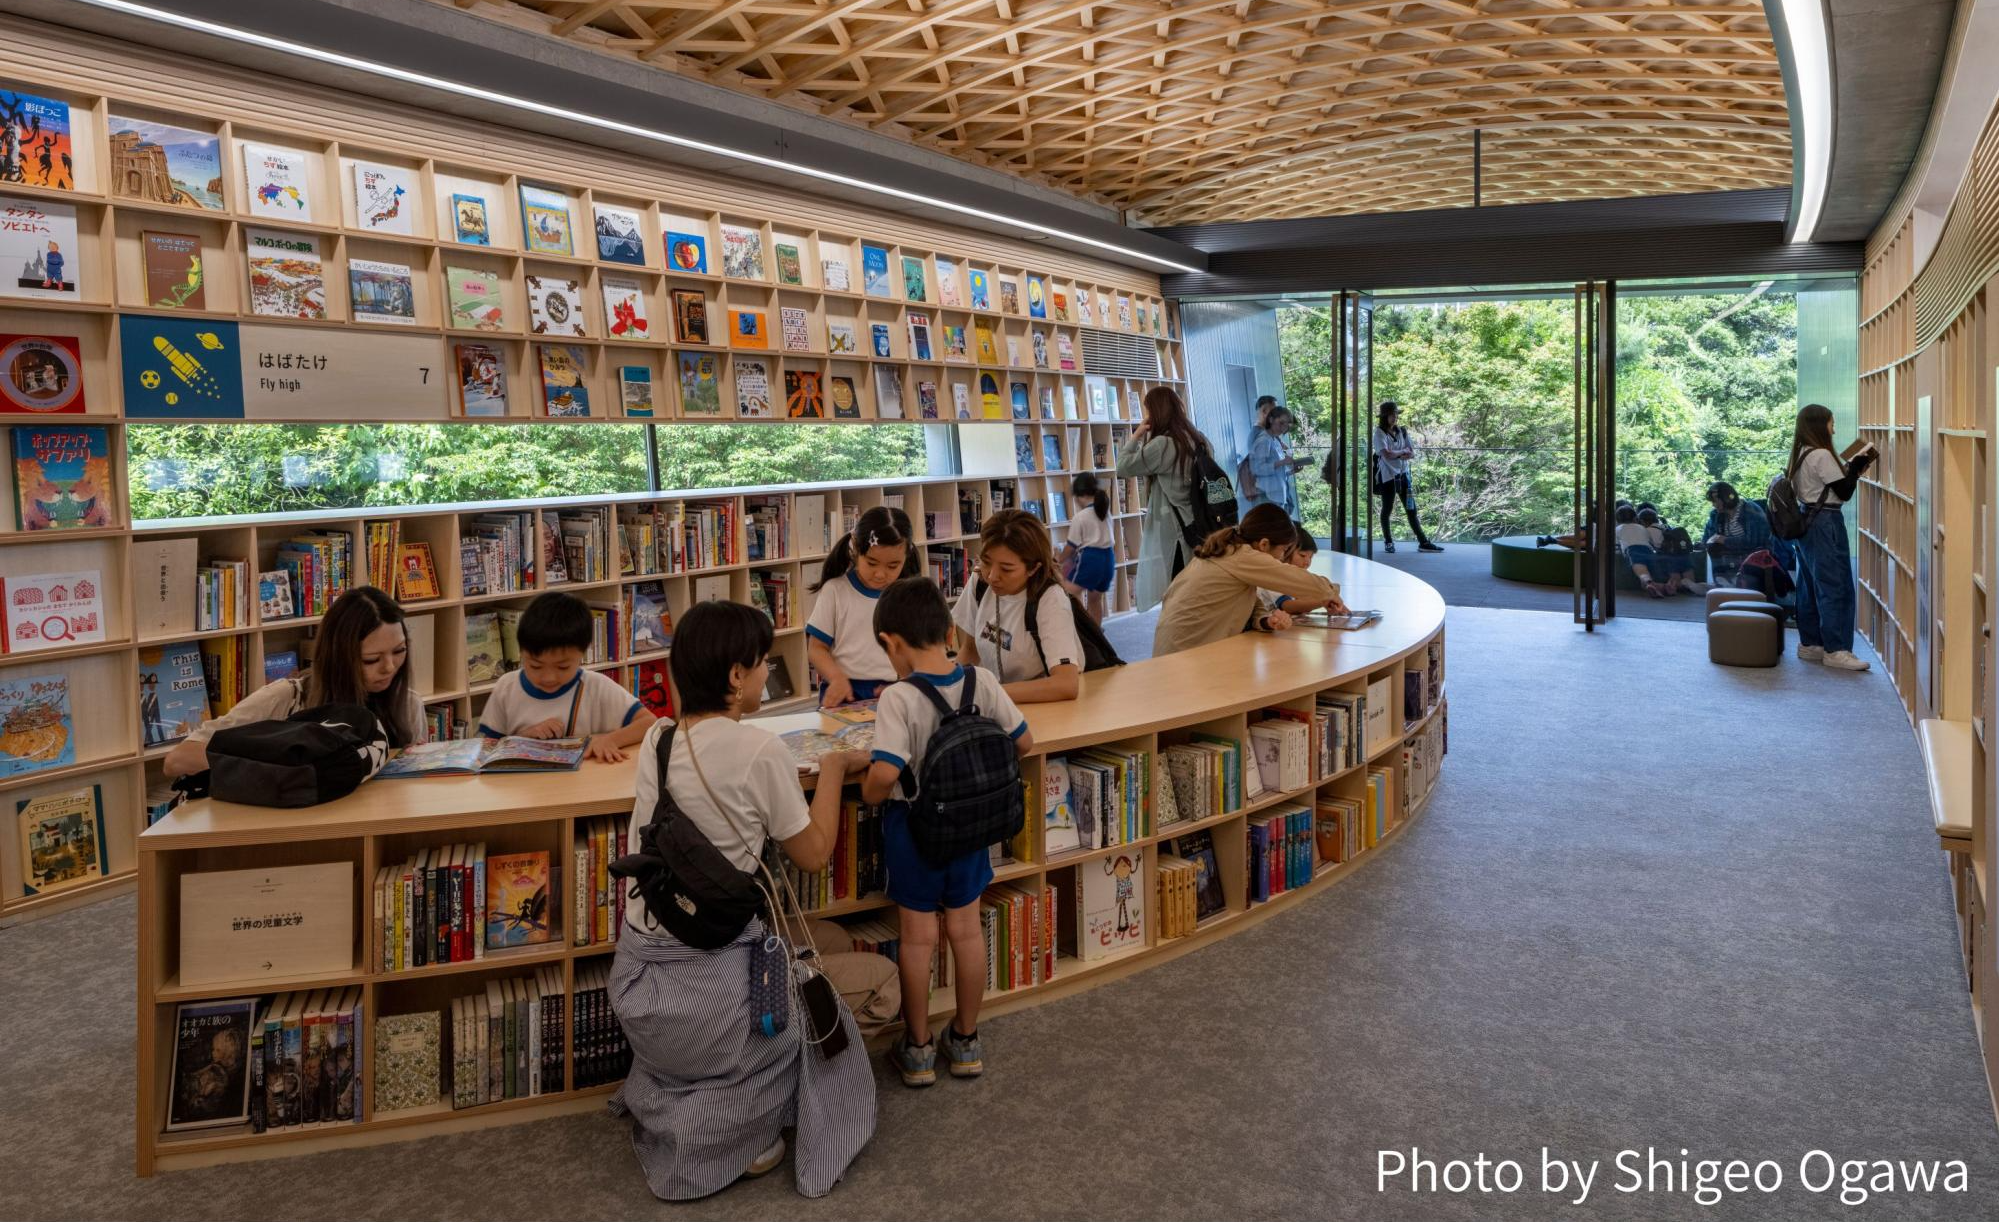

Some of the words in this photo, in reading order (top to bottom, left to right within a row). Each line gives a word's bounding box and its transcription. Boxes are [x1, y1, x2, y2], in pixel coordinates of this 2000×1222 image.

[5, 207, 46, 220] タンタン
[259, 353, 327, 370] はばたけ
[419, 367, 430, 384] 7
[260, 378, 275, 392] Fly
[279, 378, 301, 392] high
[173, 652, 200, 667] This
[181, 667, 193, 676] is
[173, 678, 204, 692] Rome
[232, 915, 304, 931] 世界の児童文学
[182, 1014, 232, 1028] オオカミ族の
